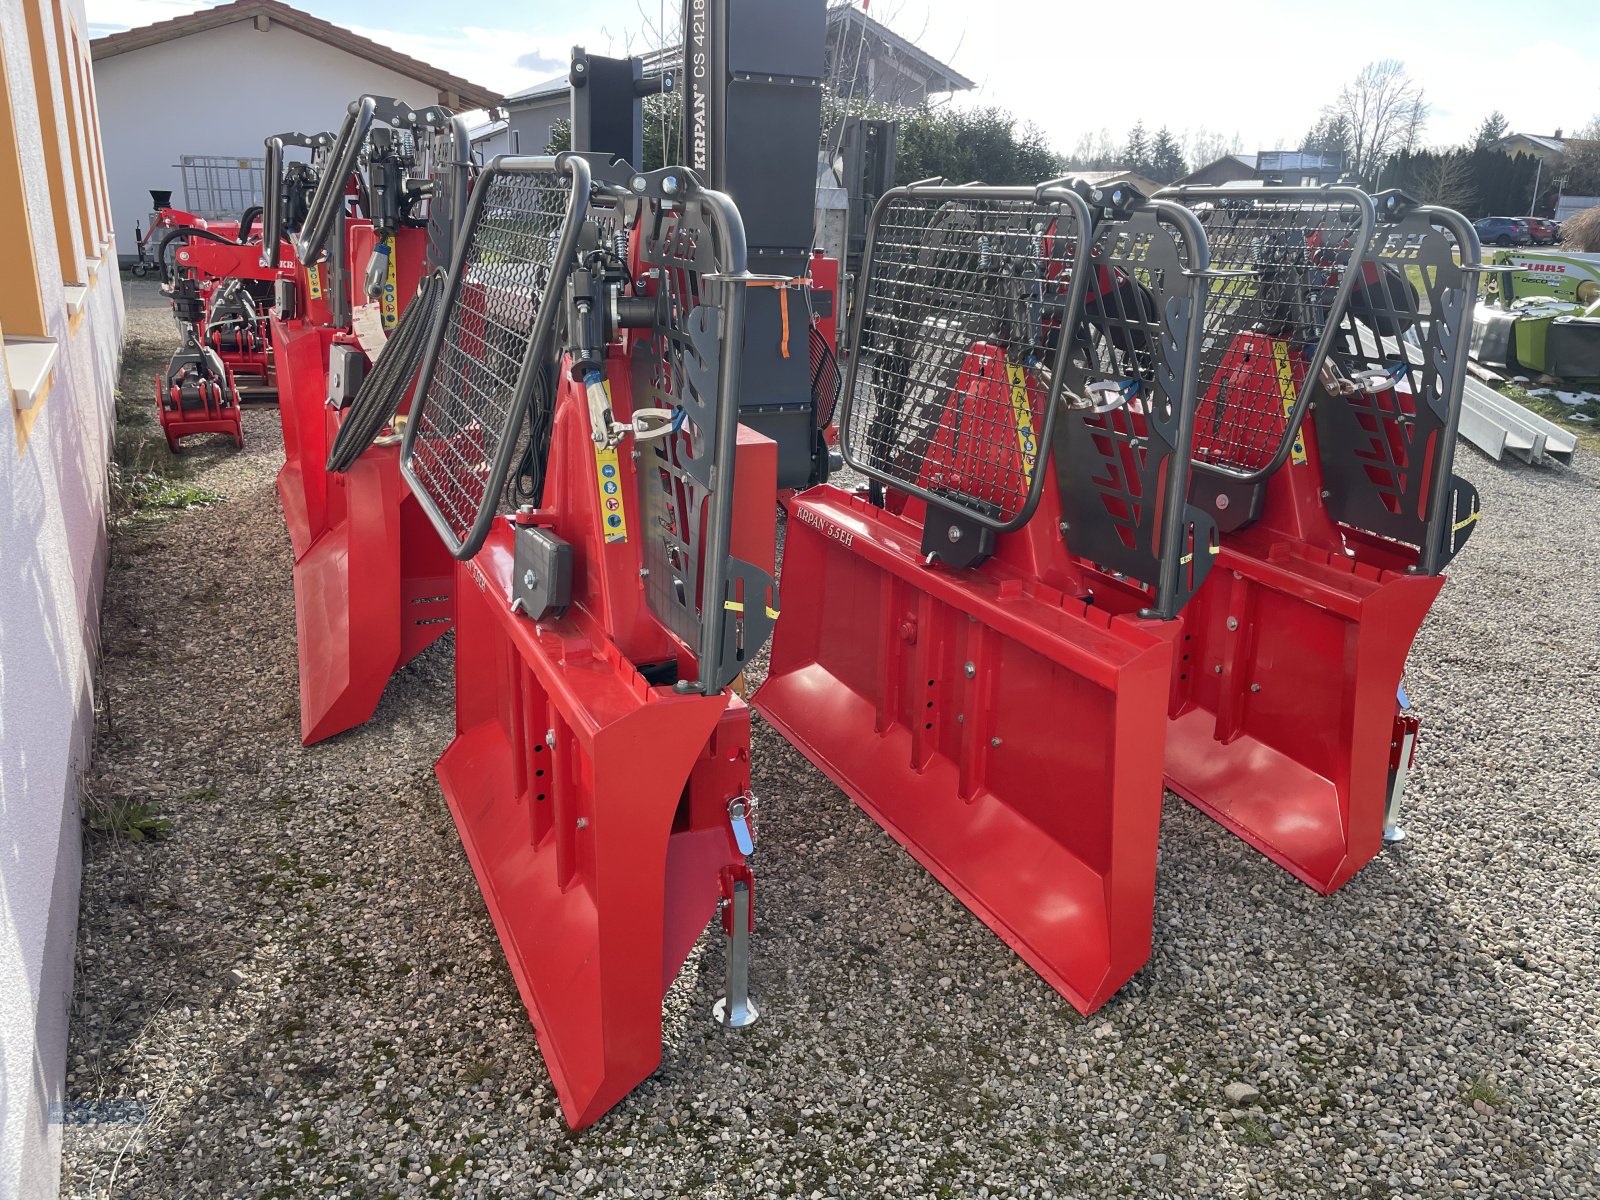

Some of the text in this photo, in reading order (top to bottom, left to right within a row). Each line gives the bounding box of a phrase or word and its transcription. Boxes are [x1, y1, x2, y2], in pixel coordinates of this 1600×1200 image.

[693, 53, 705, 78] CS
[694, 92, 706, 171] KRPAN
[796, 506, 825, 530] KRPAN
